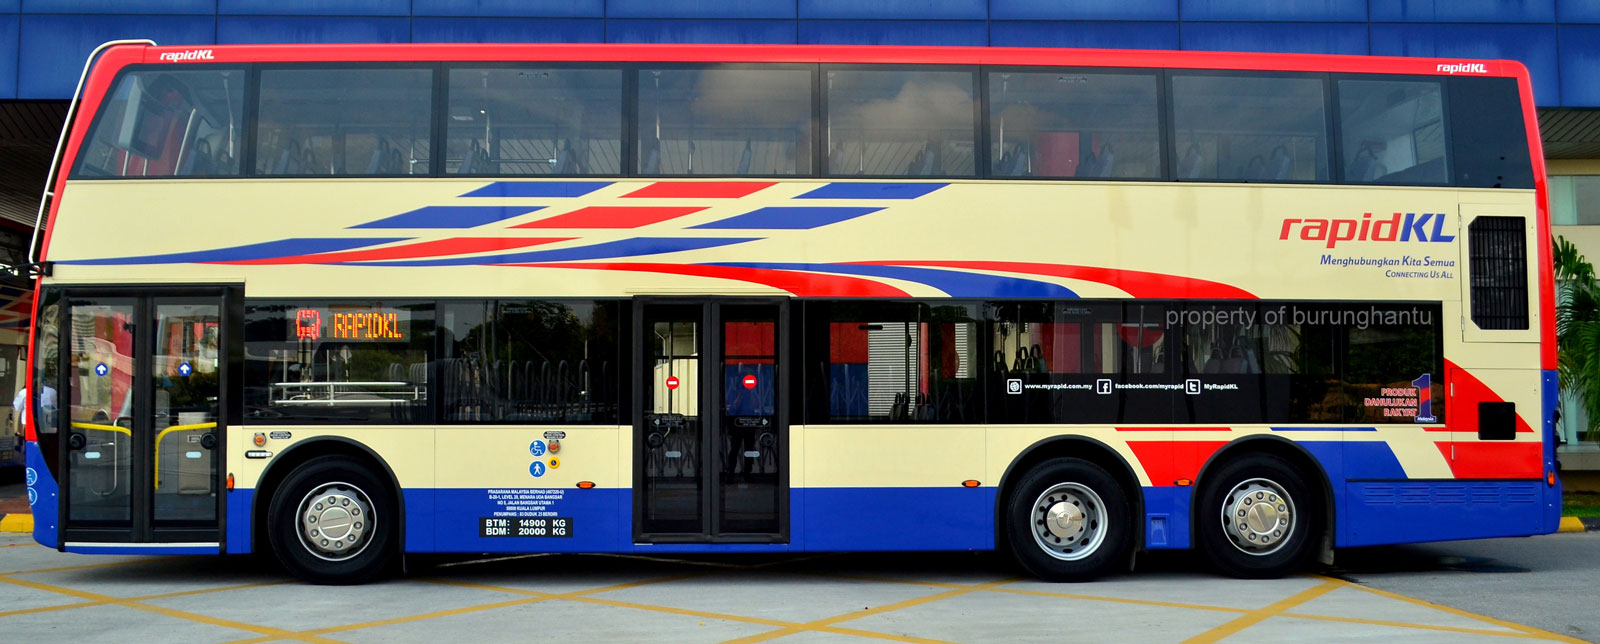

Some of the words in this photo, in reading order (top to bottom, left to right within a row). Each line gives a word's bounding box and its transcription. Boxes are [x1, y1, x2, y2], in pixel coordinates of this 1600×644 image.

[160, 49, 215, 62] rapidKL
[1436, 63, 1487, 74] rapidKL
[1279, 212, 1456, 249] rapidKL
[1320, 254, 1400, 267] Menghubungkan
[1401, 255, 1422, 266] Kita
[1423, 256, 1455, 267] Semua
[334, 313, 403, 339] RAPIDKL
[1114, 382, 1184, 391] facebook.com/myrapid
[1203, 383, 1239, 391] MyRapidKL
[1381, 387, 1417, 396] PRODUK
[1364, 397, 1418, 406] DAHULUKAN
[1383, 408, 1418, 417] RAKYAT
[485, 519, 510, 527] BTM:
[518, 519, 546, 527] 14900
[552, 519, 566, 527] KG
[485, 527, 510, 535] BDM:
[518, 527, 546, 535] 20000
[552, 527, 566, 535] KG
